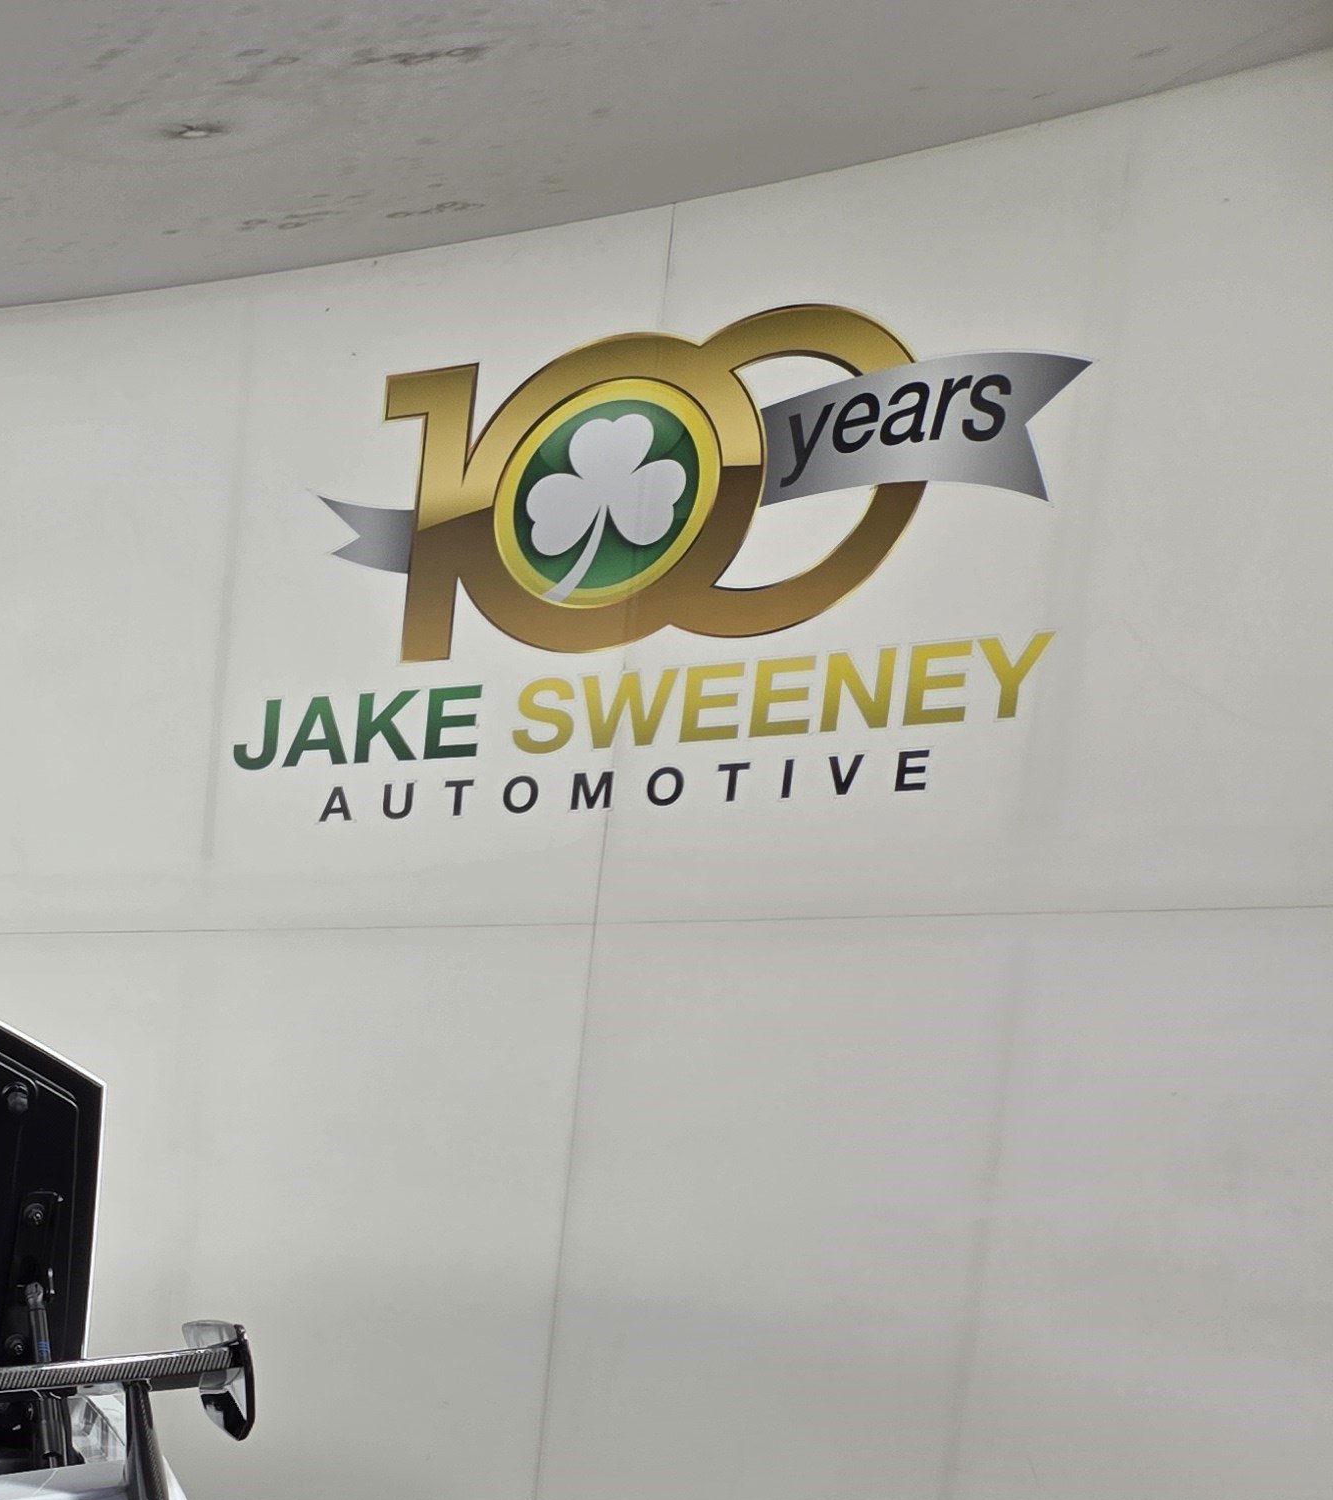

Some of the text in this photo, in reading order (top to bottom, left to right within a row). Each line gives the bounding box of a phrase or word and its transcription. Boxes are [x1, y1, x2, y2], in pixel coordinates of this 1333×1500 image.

[383, 302, 1012, 664] 100 years
[233, 631, 1056, 771] JAKE SWEENEY
[318, 748, 930, 823] AUTOMOTIVE
